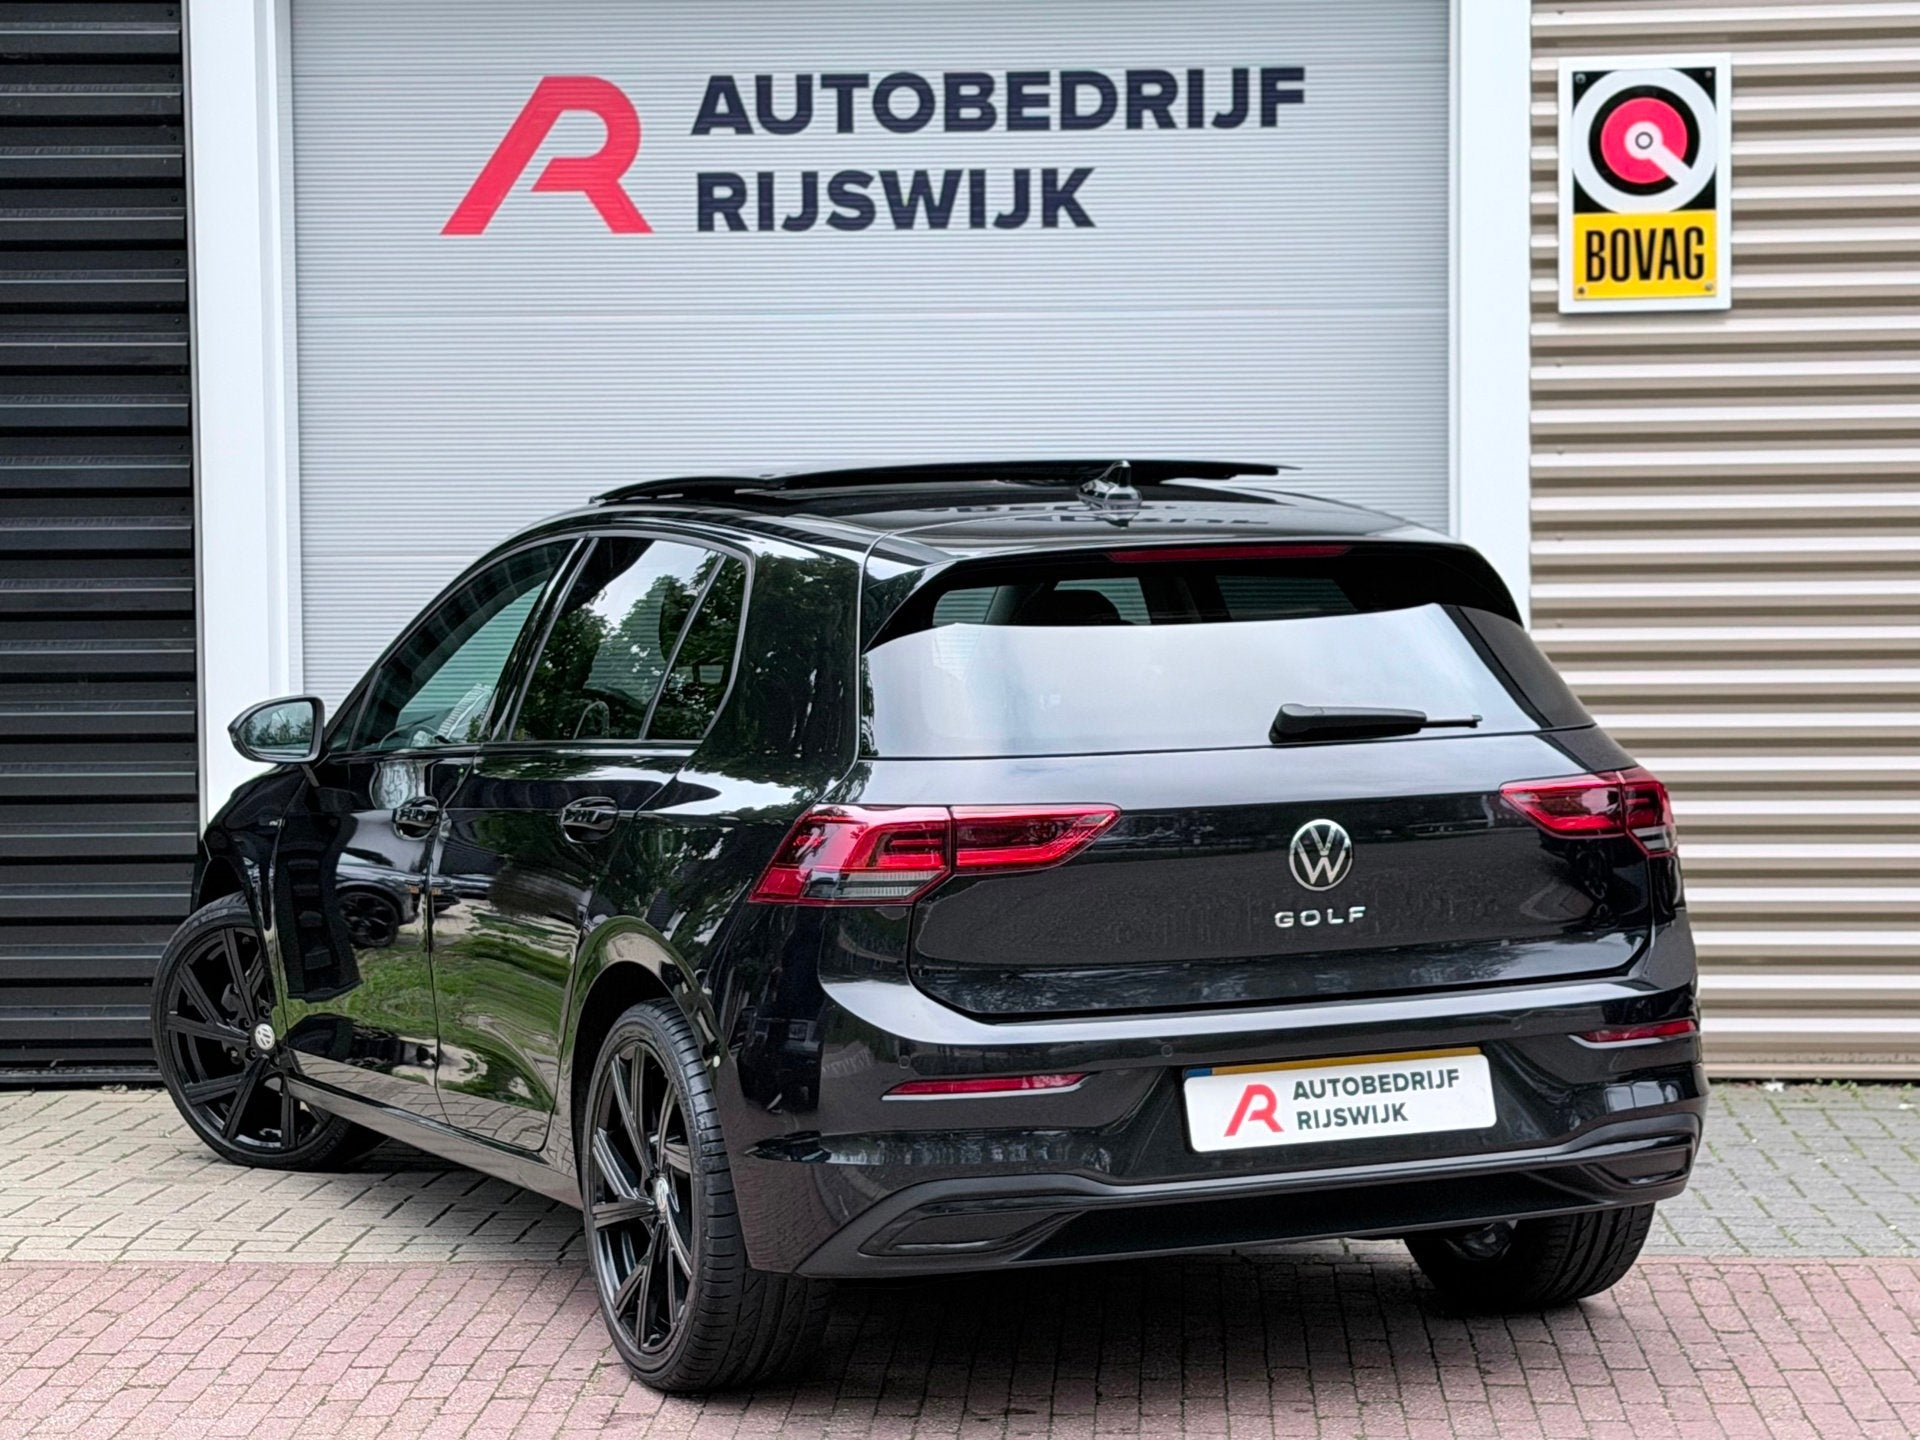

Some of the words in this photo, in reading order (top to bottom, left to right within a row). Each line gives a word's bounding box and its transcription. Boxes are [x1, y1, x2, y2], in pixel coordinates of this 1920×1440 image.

[691, 66, 1305, 136] AUTOBEDRIJF
[697, 167, 1097, 232] RIJSWIJK
[1586, 226, 1704, 283] BOVAG
[1274, 905, 1366, 928] GOLF
[1292, 1068, 1460, 1101] AUTOBEDRIJF
[1296, 1102, 1409, 1131] RIJSWIJK
